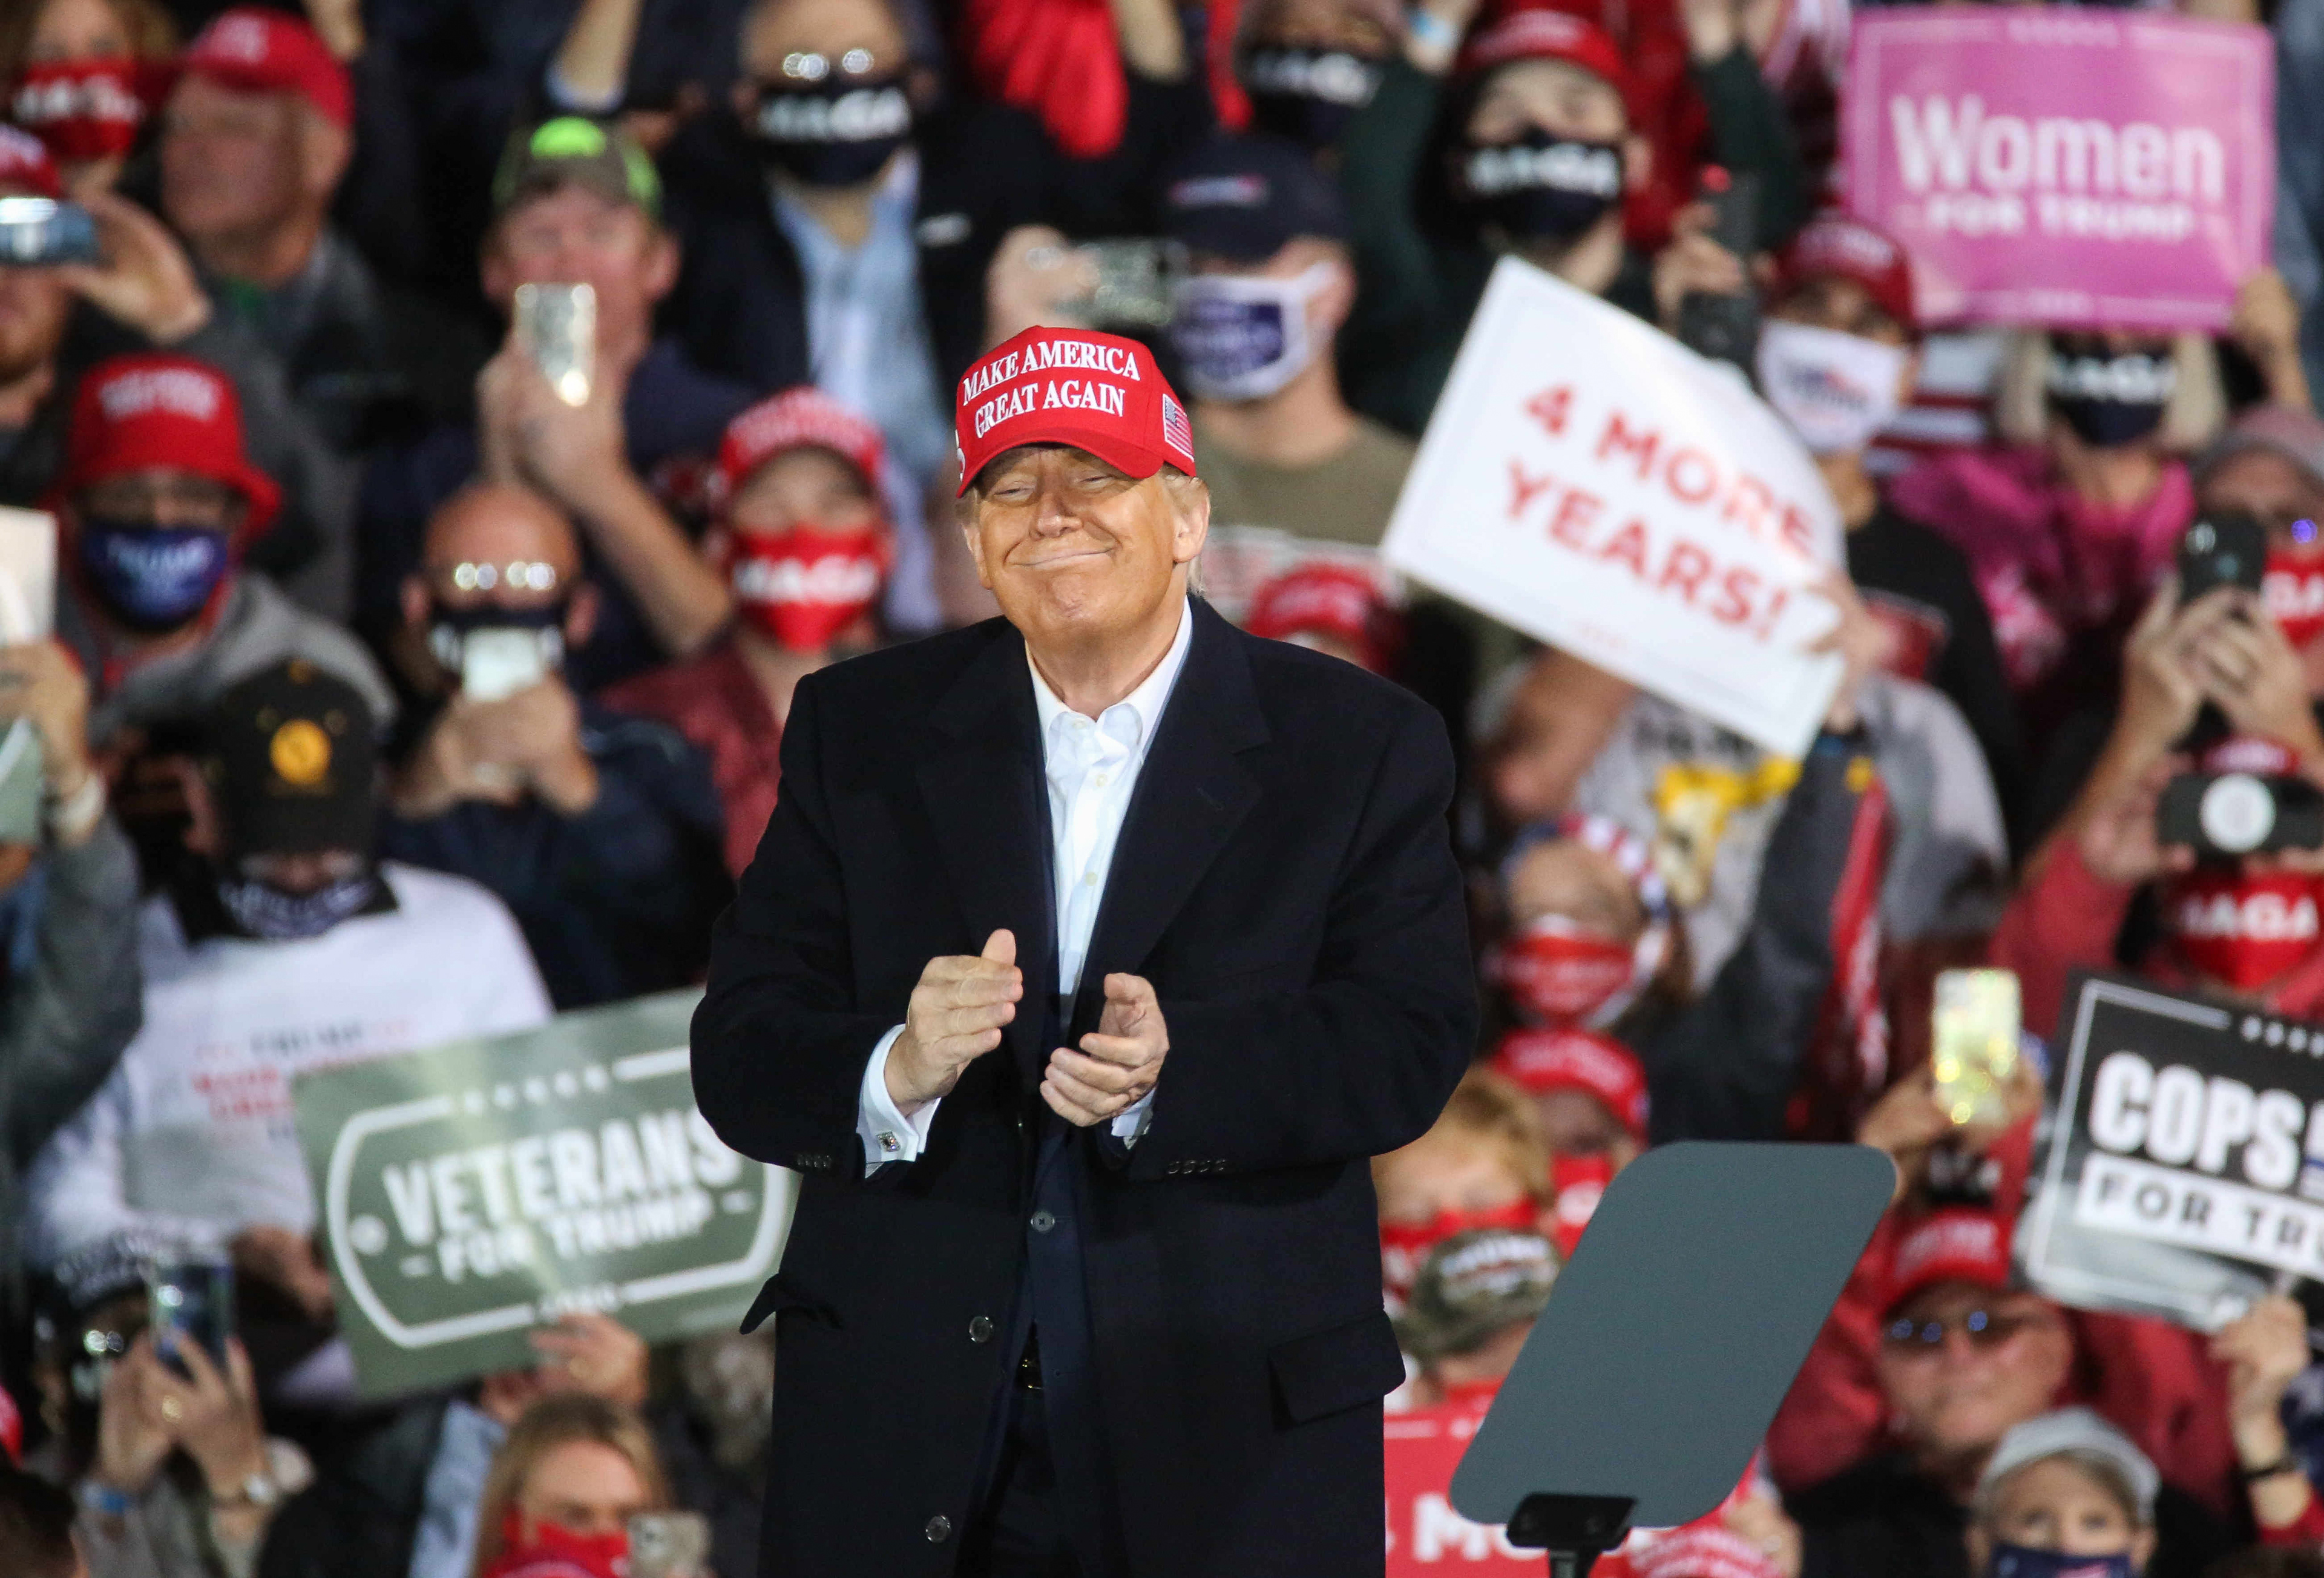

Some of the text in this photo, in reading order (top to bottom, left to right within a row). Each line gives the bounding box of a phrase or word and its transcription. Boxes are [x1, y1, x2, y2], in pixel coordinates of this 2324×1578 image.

[1891, 94, 2224, 205] Women
[1929, 194, 2191, 238] FOR TRUMP
[963, 351, 1019, 406] MAKE
[1020, 340, 1140, 381] AMERICA
[974, 380, 1126, 438] GREAT AGAIN
[1525, 384, 1812, 557] 4 MORE
[1506, 457, 1790, 643] YEARS!
[2089, 1051, 2306, 1190] COPS
[382, 1106, 742, 1246] VETERANS
[2099, 1172, 2324, 1257] FOR TR
[437, 1189, 713, 1283] FOR TRUMP
